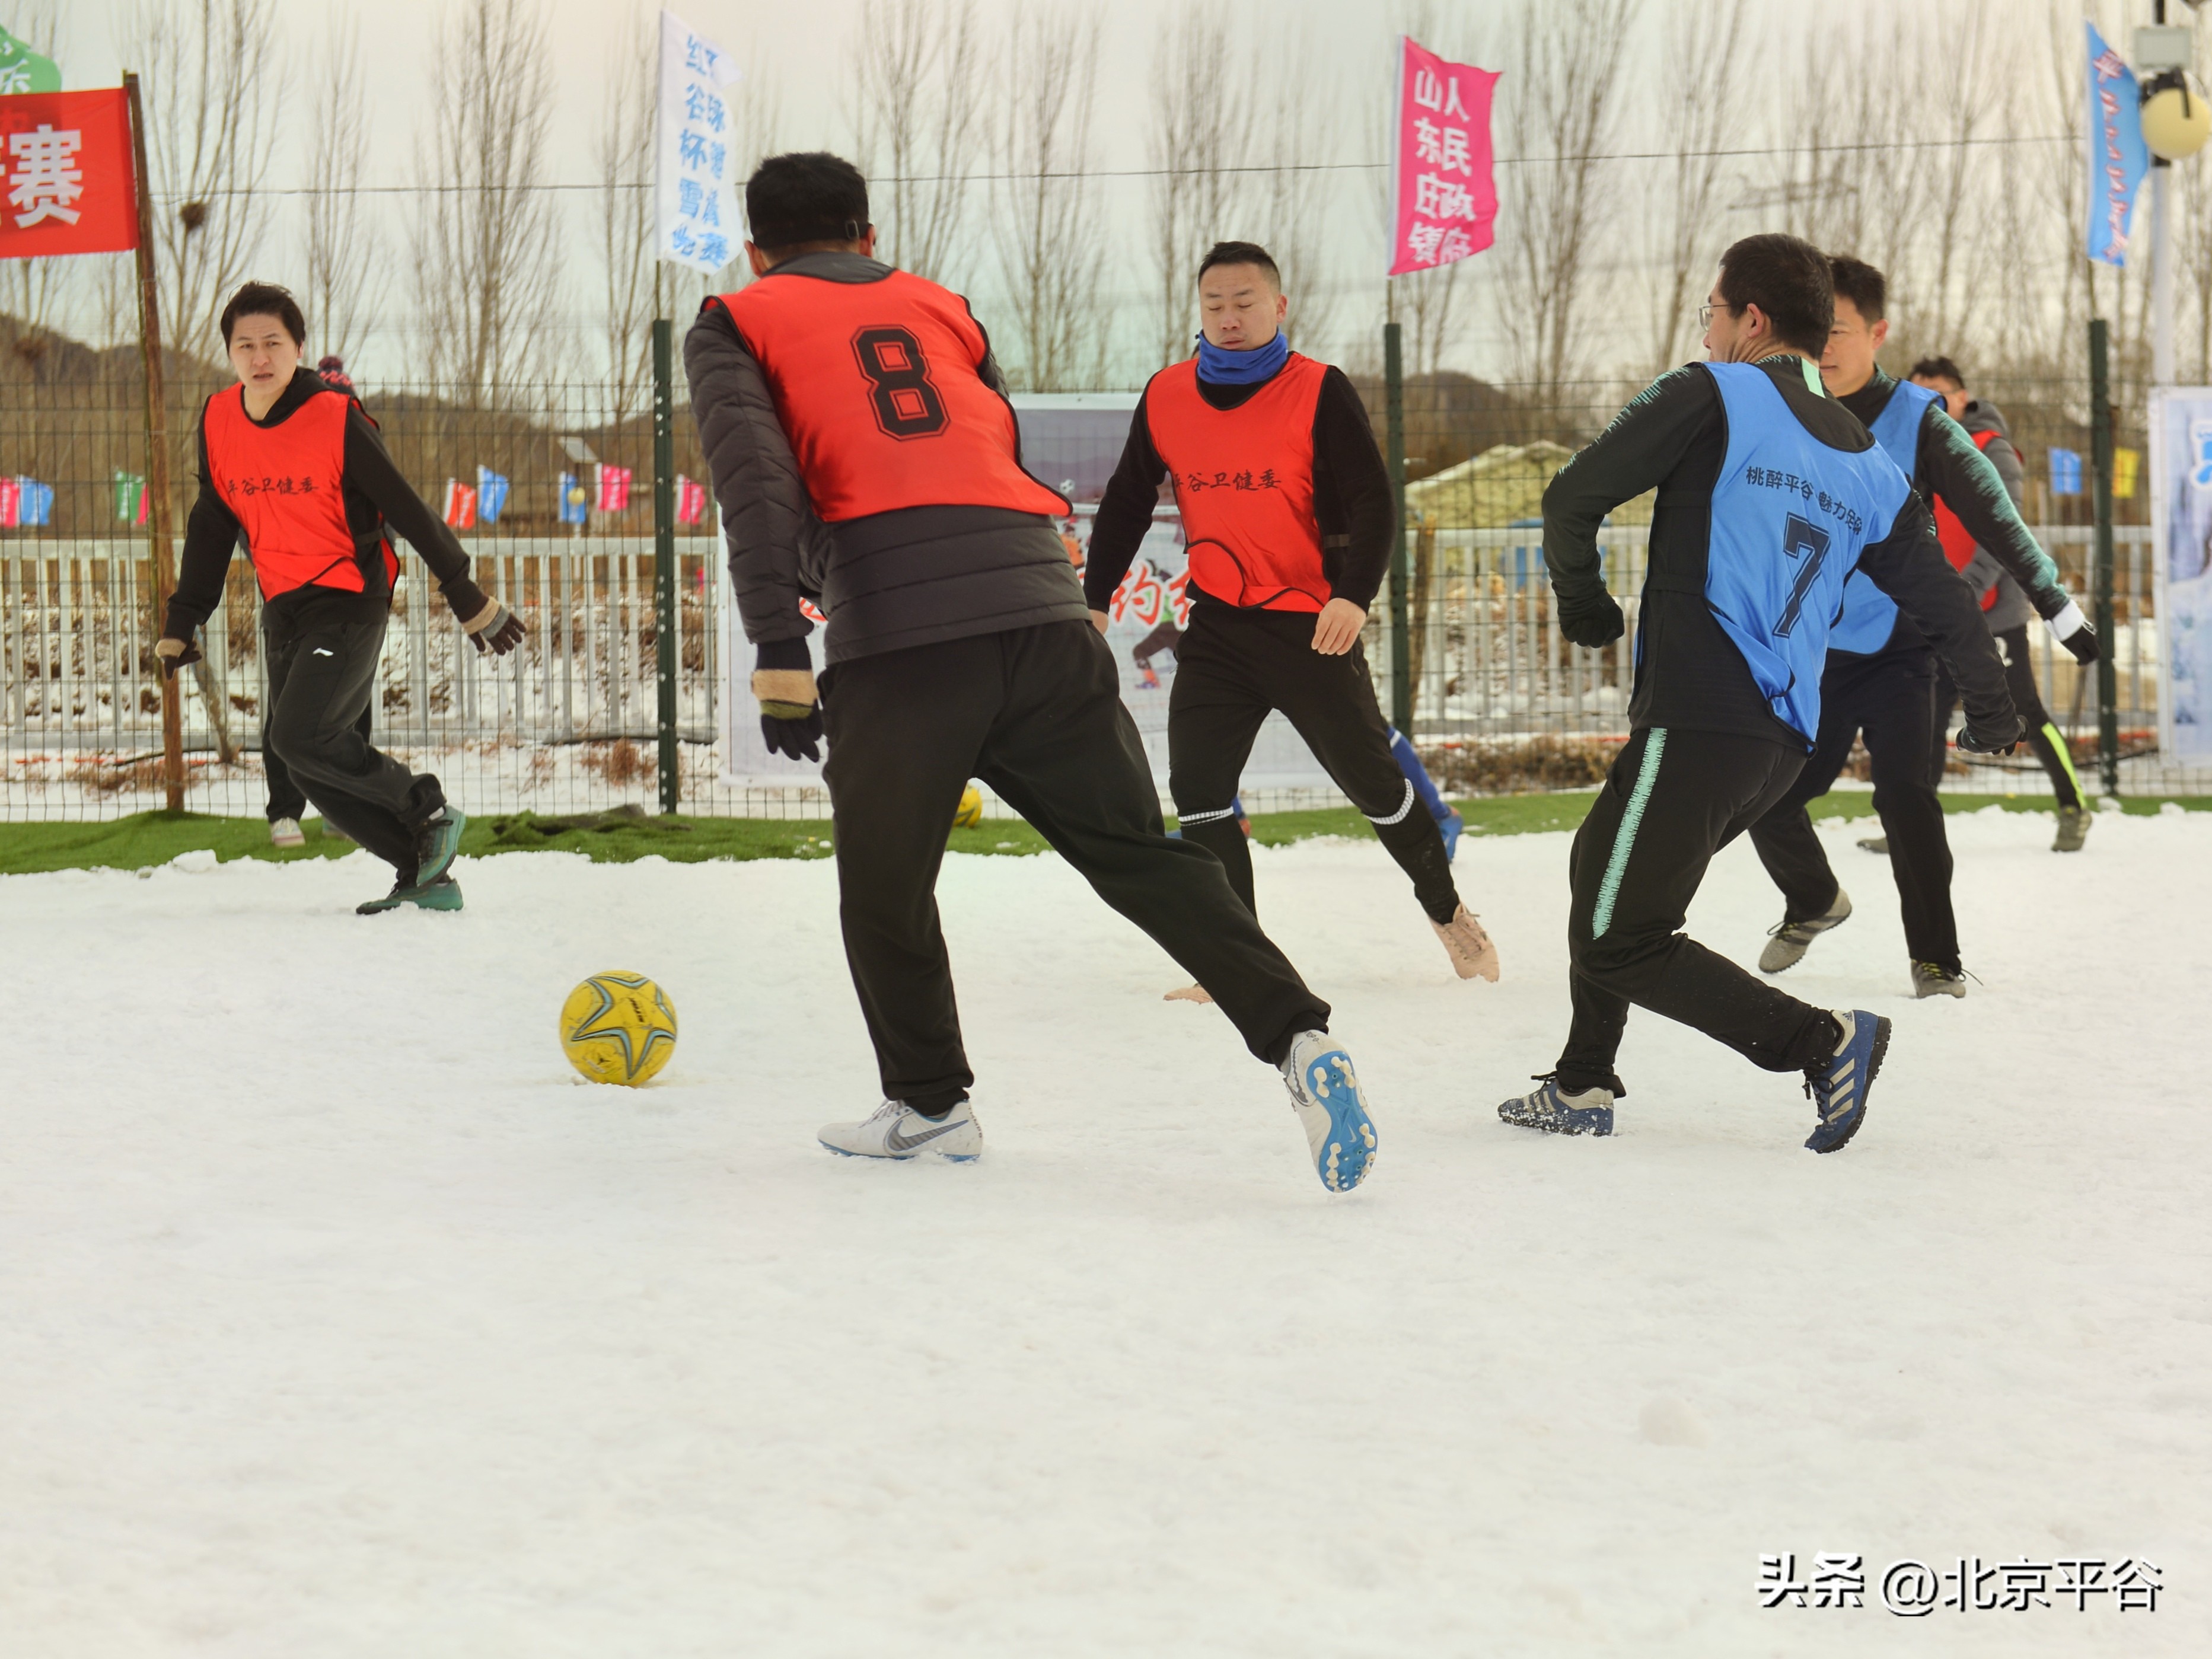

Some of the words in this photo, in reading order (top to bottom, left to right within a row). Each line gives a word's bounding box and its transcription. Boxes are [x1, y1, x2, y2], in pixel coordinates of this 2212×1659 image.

[0, 123, 84, 229] 赛
[850, 324, 951, 442] 8
[1772, 511, 1831, 639] 7
